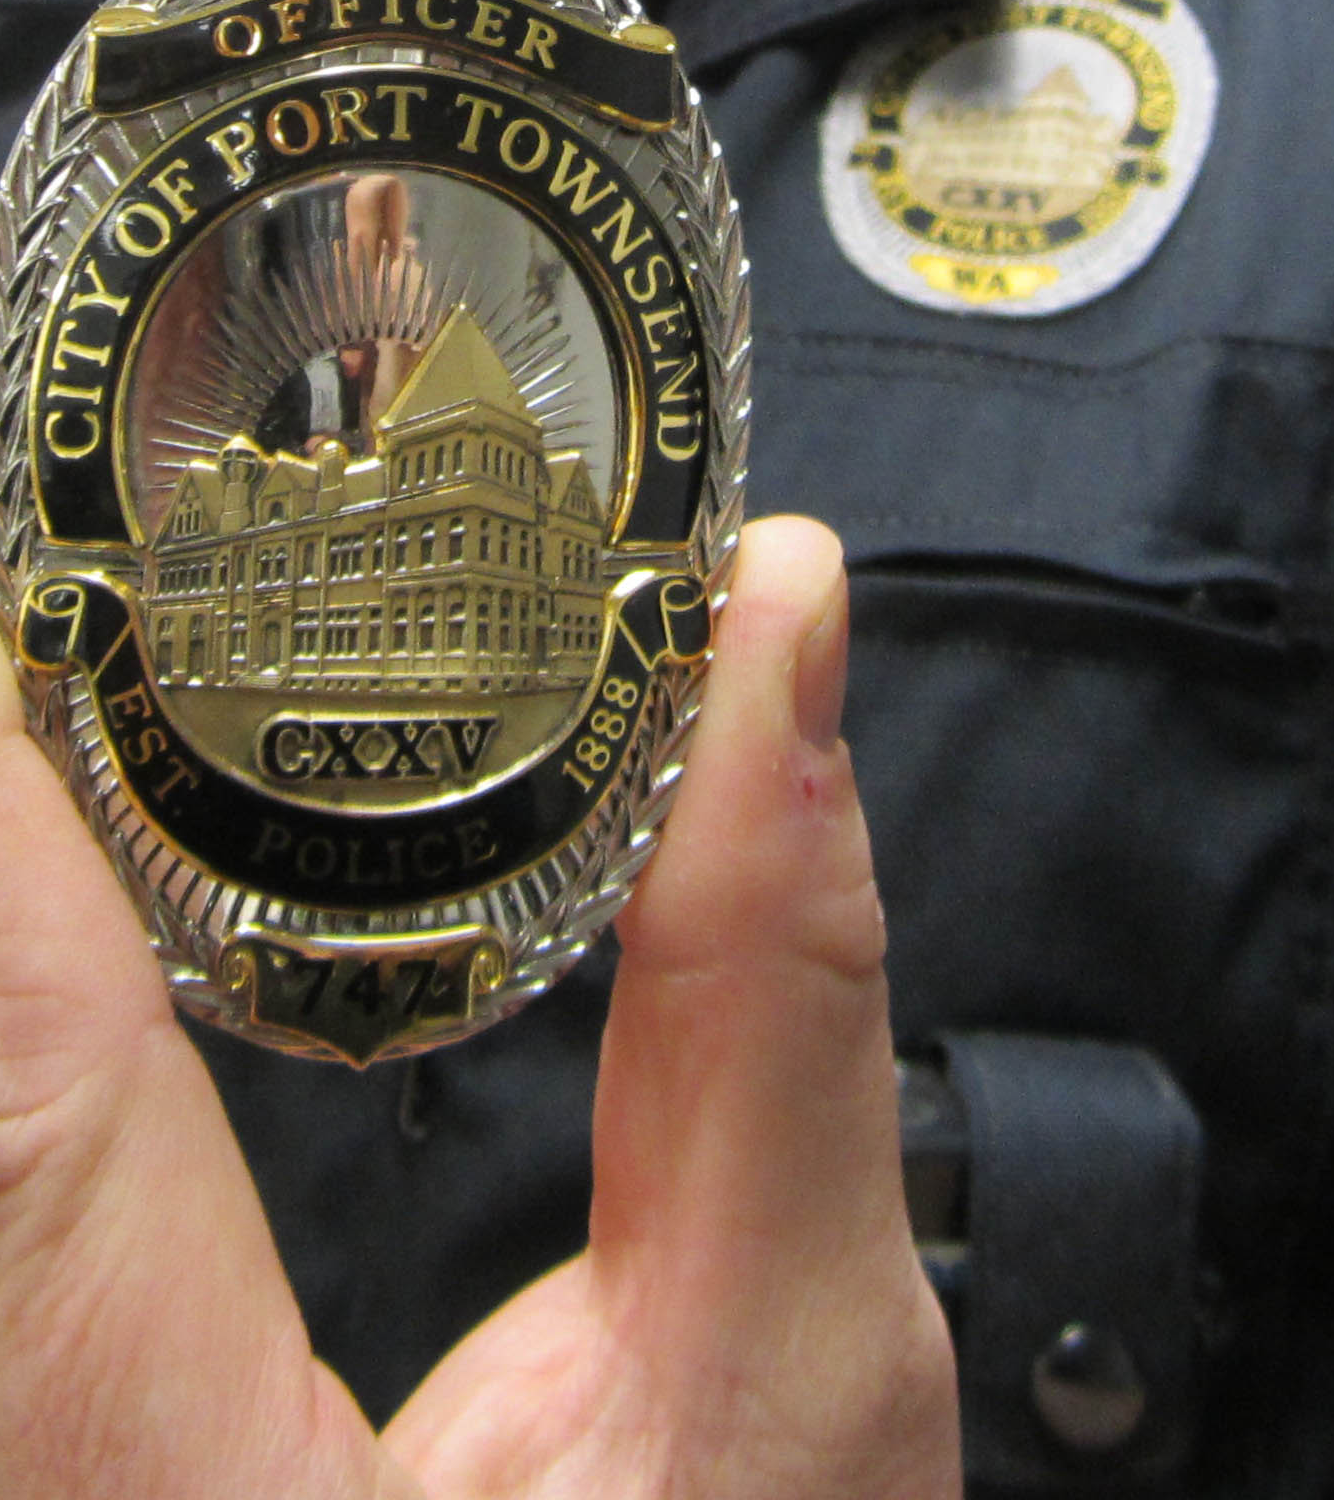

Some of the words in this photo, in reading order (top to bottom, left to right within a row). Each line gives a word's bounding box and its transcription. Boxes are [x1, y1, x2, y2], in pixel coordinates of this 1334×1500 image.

[45, 261, 132, 461] CITY
[114, 158, 213, 259] OF
[207, 85, 428, 190] PORT
[455, 93, 700, 463] TOWNSEND
[248, 817, 499, 885] POLICE
[562, 676, 639, 795] 1888
[259, 714, 500, 782] CXXV
[294, 959, 438, 1016] 747
